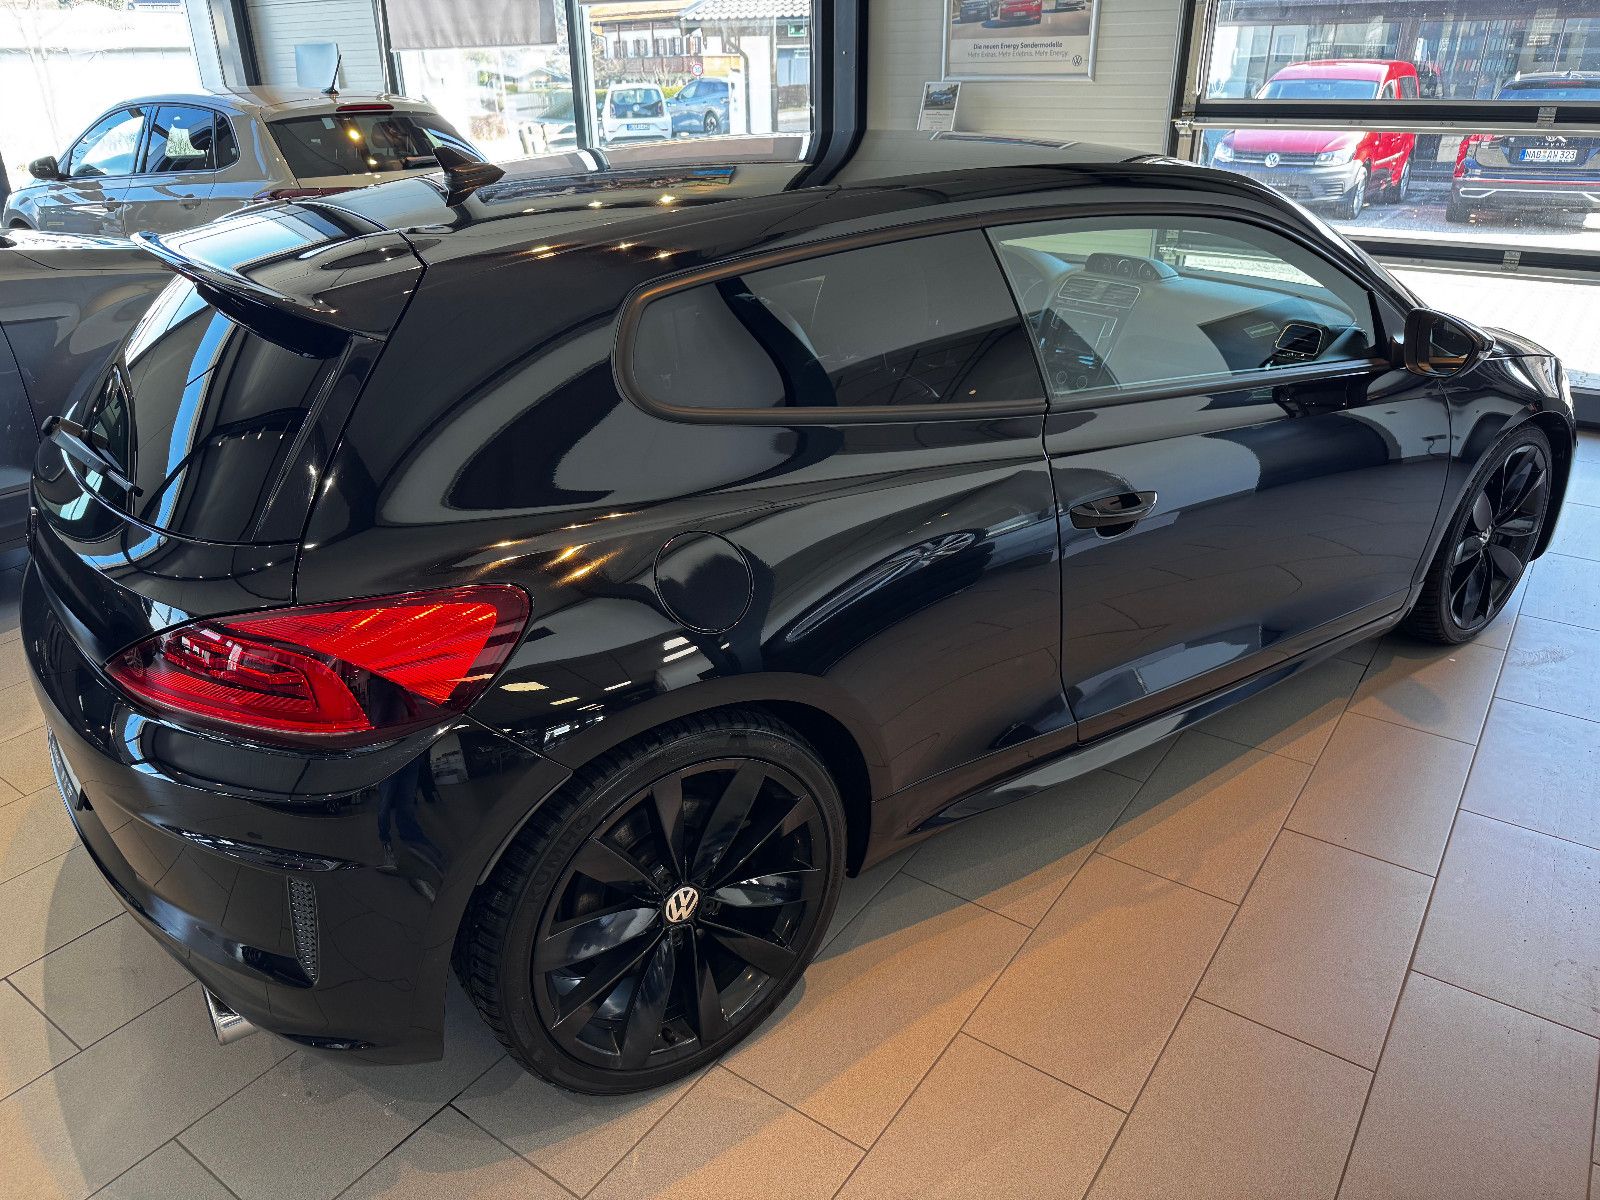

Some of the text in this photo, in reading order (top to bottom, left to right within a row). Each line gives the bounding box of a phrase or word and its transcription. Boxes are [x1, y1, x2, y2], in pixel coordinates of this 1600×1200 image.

[1000, 43, 1019, 51] Energy
[1020, 41, 1063, 49] Sondermodelle
[1559, 150, 1576, 159] 323
